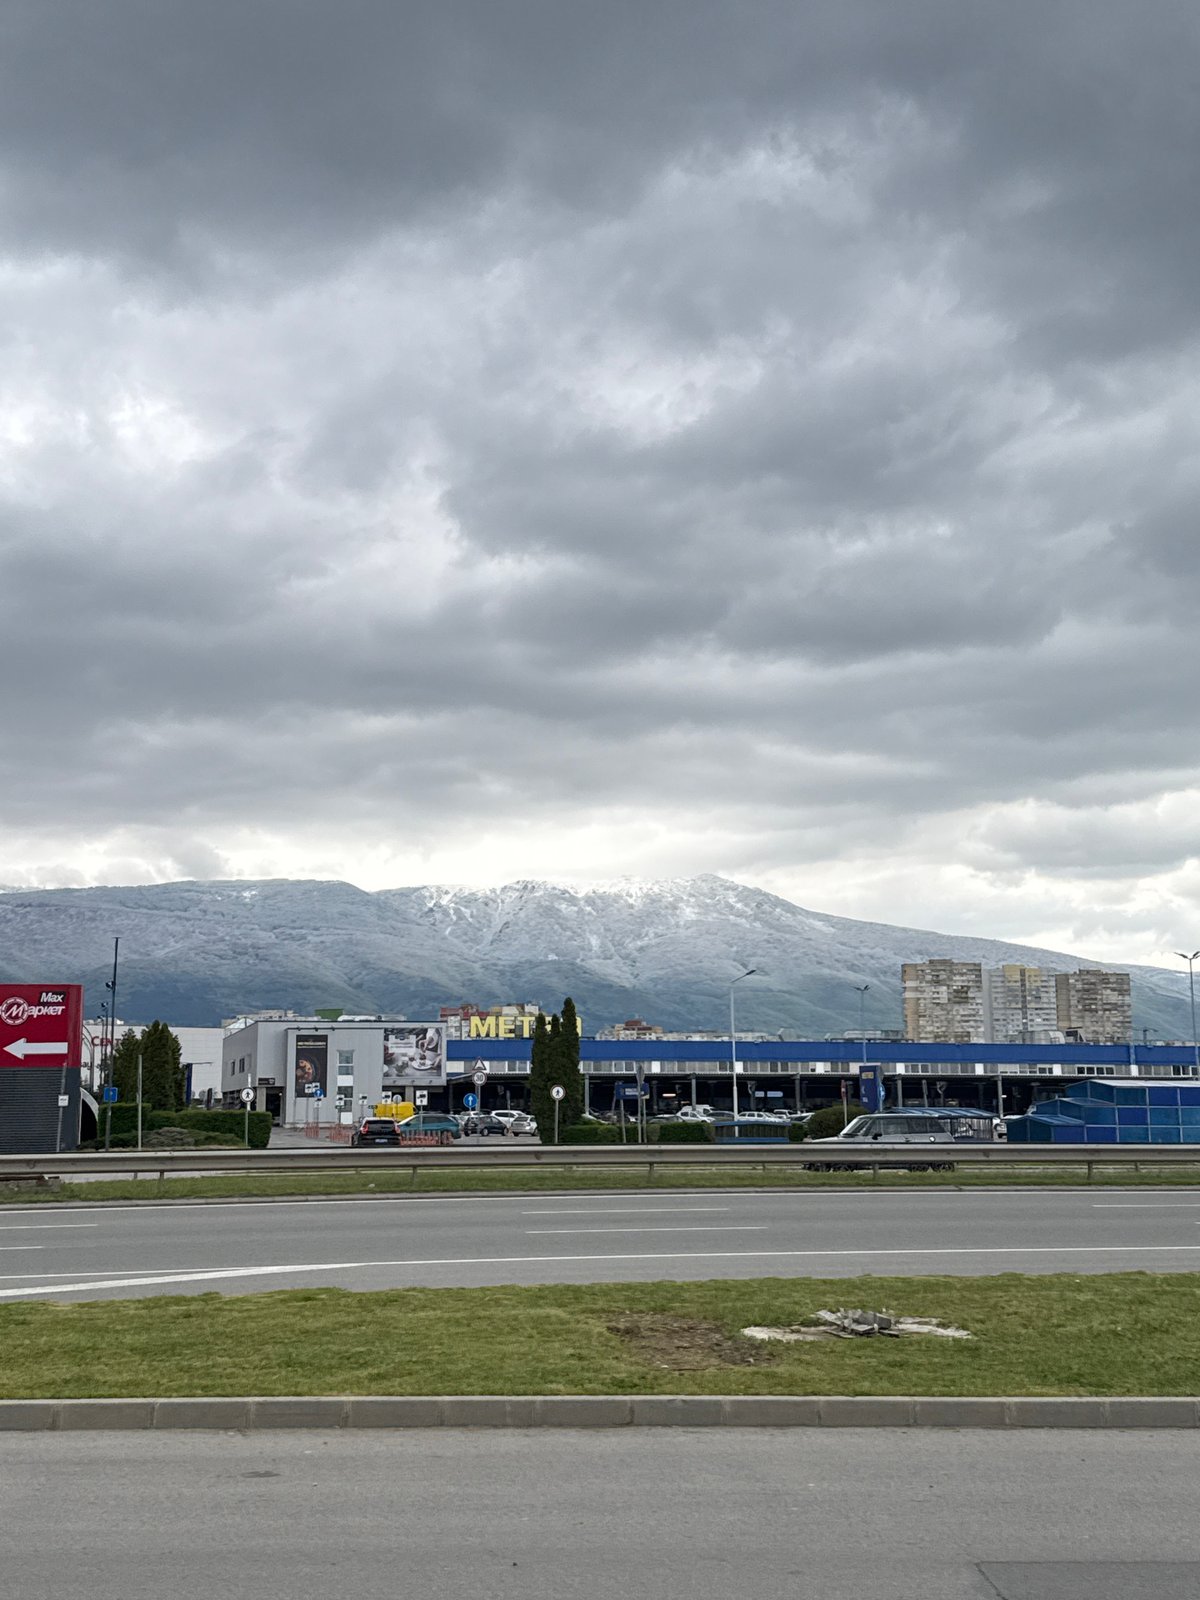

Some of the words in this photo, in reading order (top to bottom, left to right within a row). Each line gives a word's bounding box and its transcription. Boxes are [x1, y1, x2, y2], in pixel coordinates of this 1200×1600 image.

[40, 992, 64, 1003] Max
[470, 1015, 582, 1038] MET
[475, 1073, 484, 1082] 30
